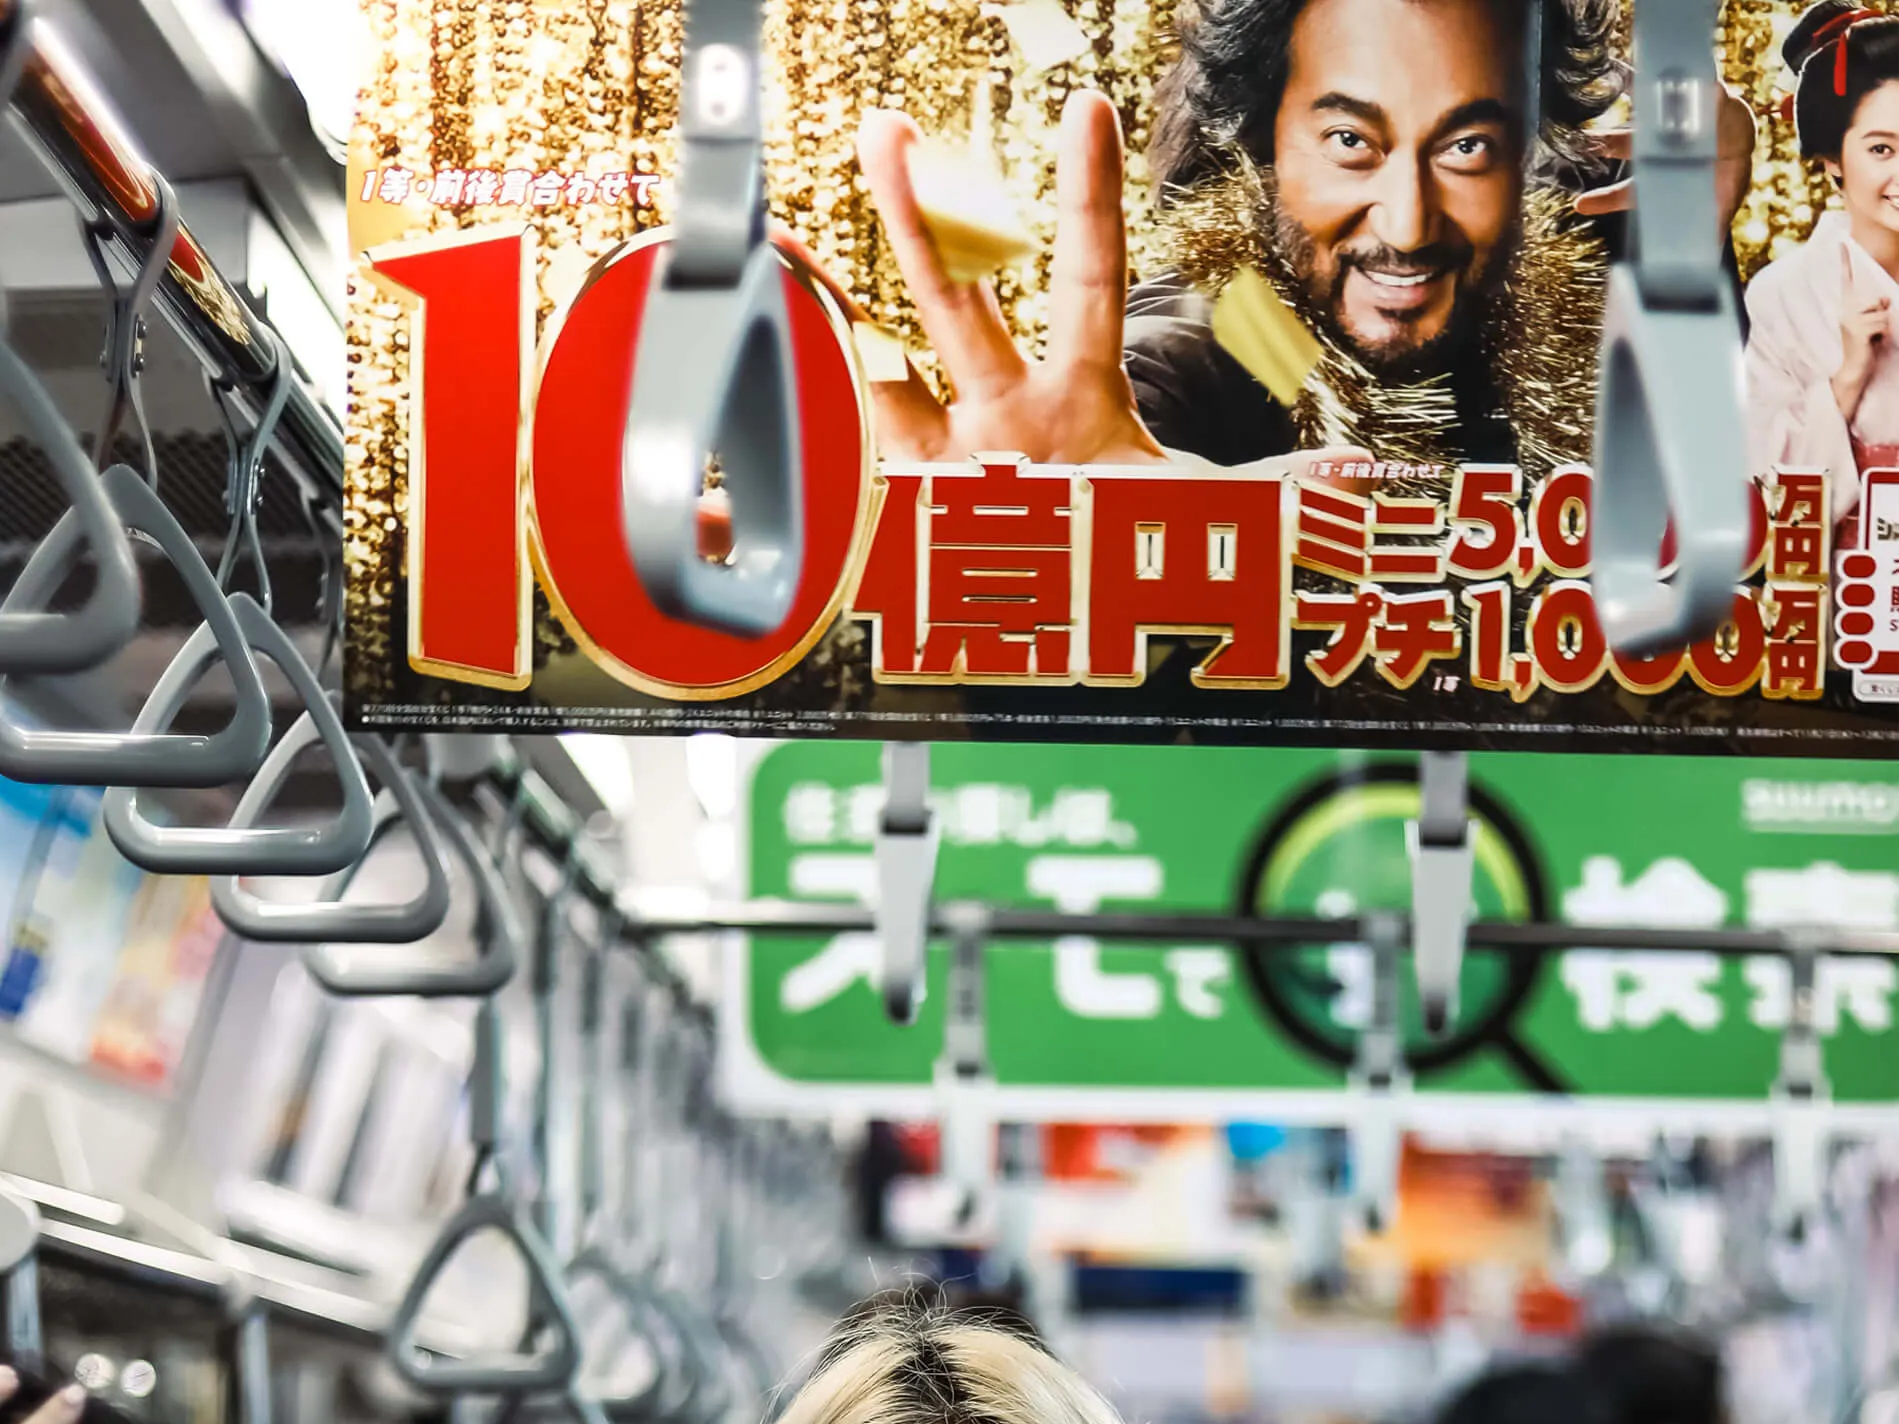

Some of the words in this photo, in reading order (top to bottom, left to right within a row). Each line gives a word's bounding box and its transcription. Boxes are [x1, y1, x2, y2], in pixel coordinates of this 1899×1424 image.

[360, 167, 662, 206] 1等・前後賞合わせて
[1294, 463, 1833, 585] ミニ5,0万円
